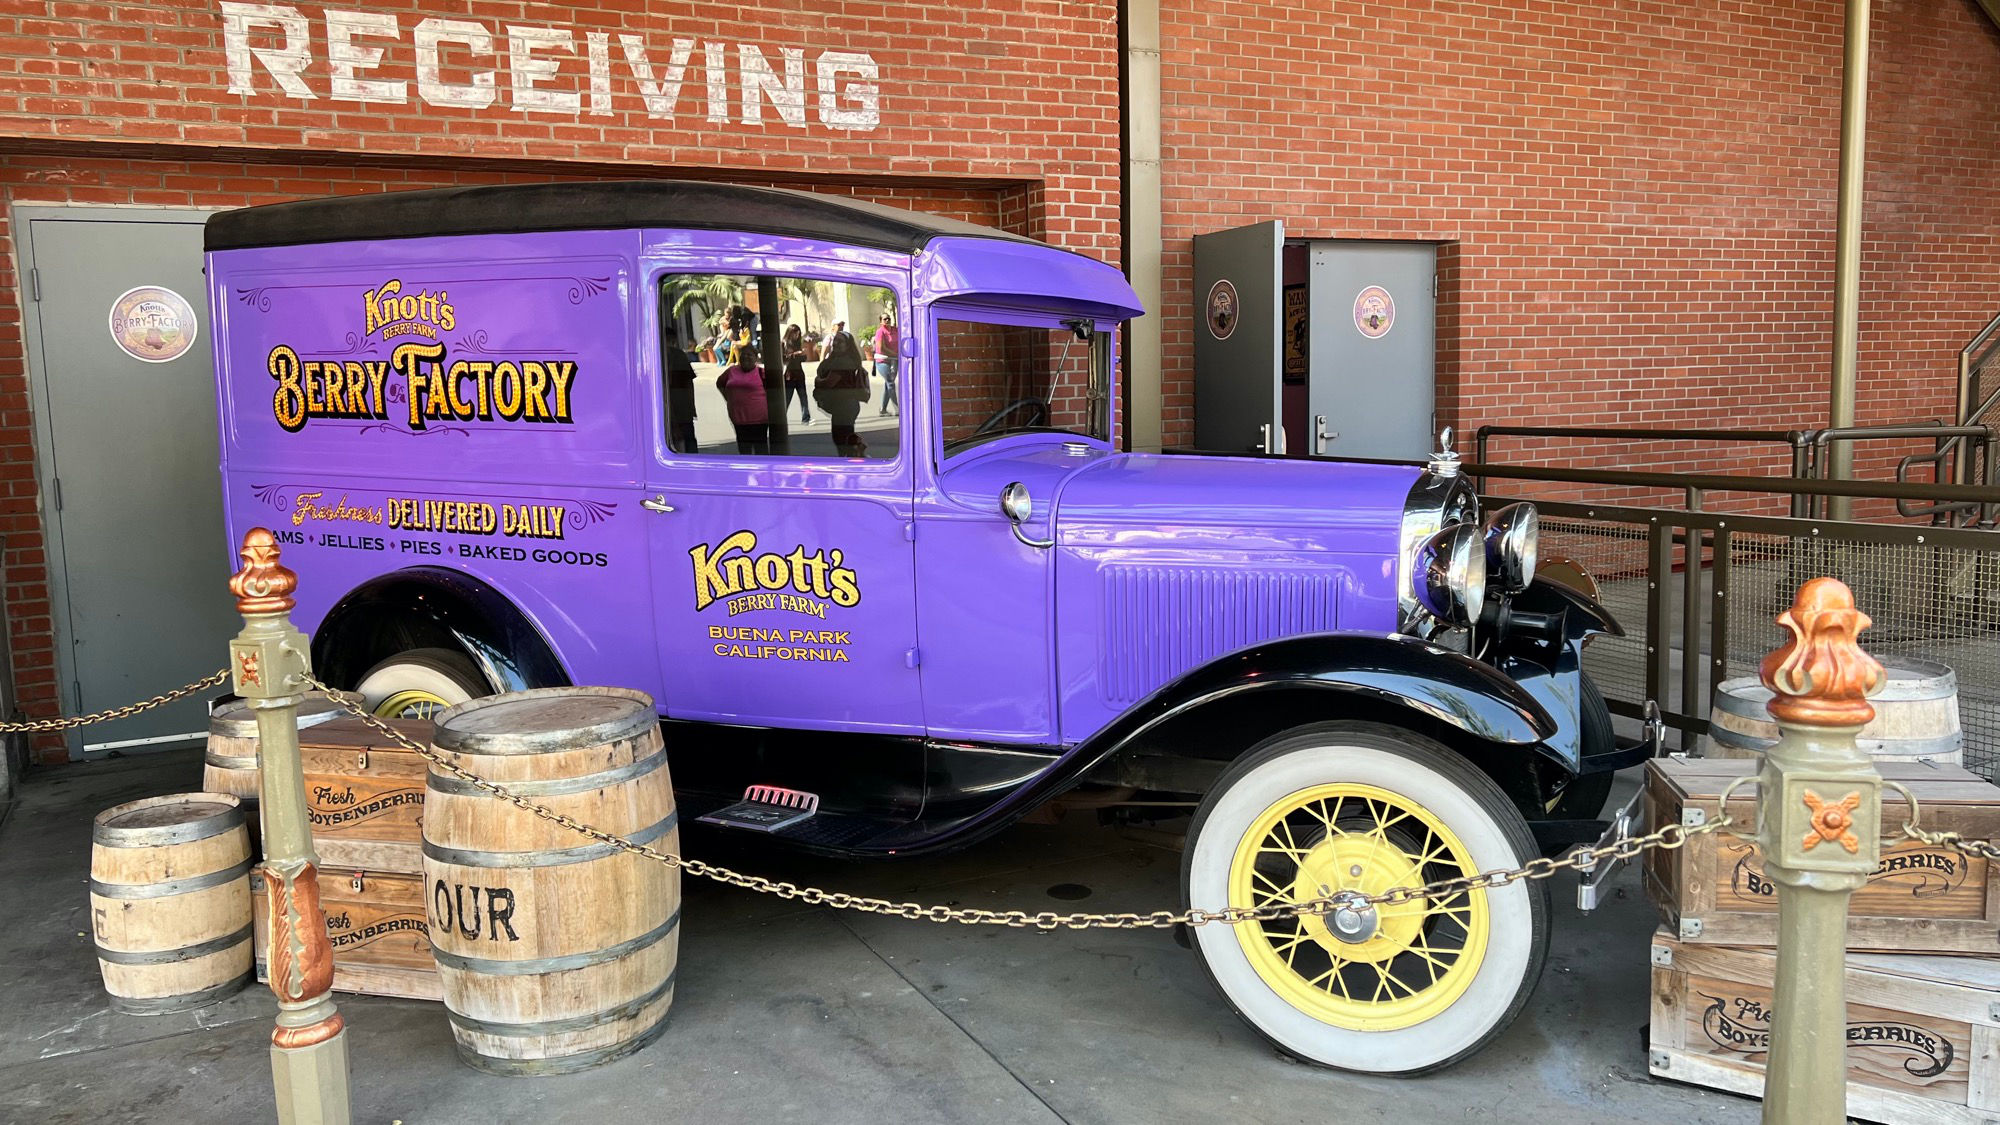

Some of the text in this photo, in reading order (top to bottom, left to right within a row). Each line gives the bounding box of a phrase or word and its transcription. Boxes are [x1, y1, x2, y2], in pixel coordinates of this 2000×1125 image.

[219, 1, 881, 132] RECEIVING
[363, 279, 456, 337] Knott's
[383, 322, 437, 342] BERRY FARM
[267, 341, 578, 433] BERRY FACTORY
[292, 491, 565, 540] Freshness DELIVERED DAILY
[273, 531, 608, 567] AMS JELLIES PIES BAKED GOODS
[688, 529, 861, 612] Knott's
[727, 593, 827, 619] BERRY FARM
[708, 625, 851, 645] BUENA PARK
[713, 643, 849, 662] CALIFORNIA
[313, 786, 356, 804] Fresh
[327, 911, 351, 929] esh
[1735, 997, 1771, 1023] Fre
